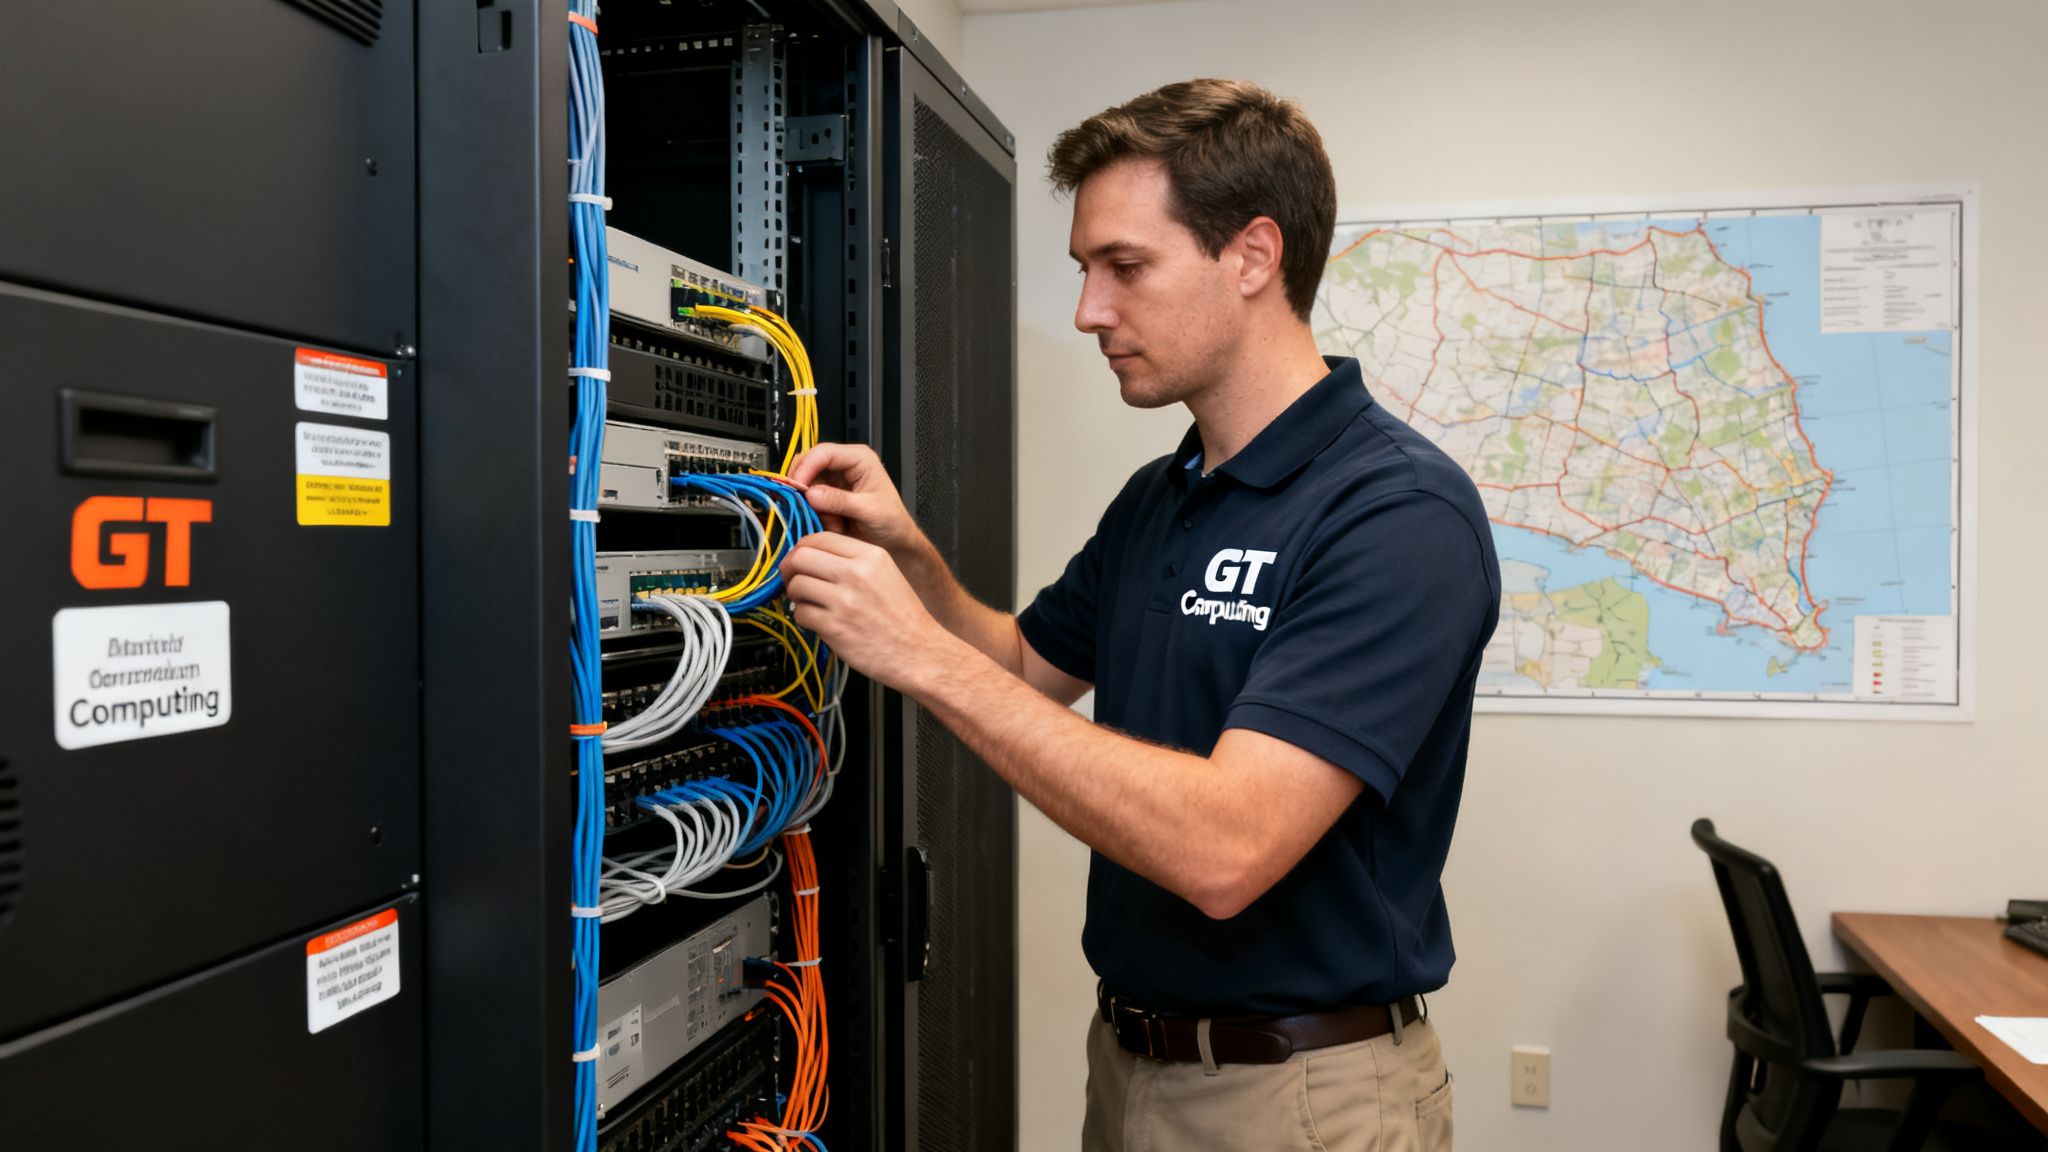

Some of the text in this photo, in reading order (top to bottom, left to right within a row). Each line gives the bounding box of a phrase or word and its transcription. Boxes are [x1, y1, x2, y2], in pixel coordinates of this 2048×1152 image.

[70, 495, 213, 590] GT
[1204, 548, 1278, 595] GT
[69, 686, 220, 729] Computing
